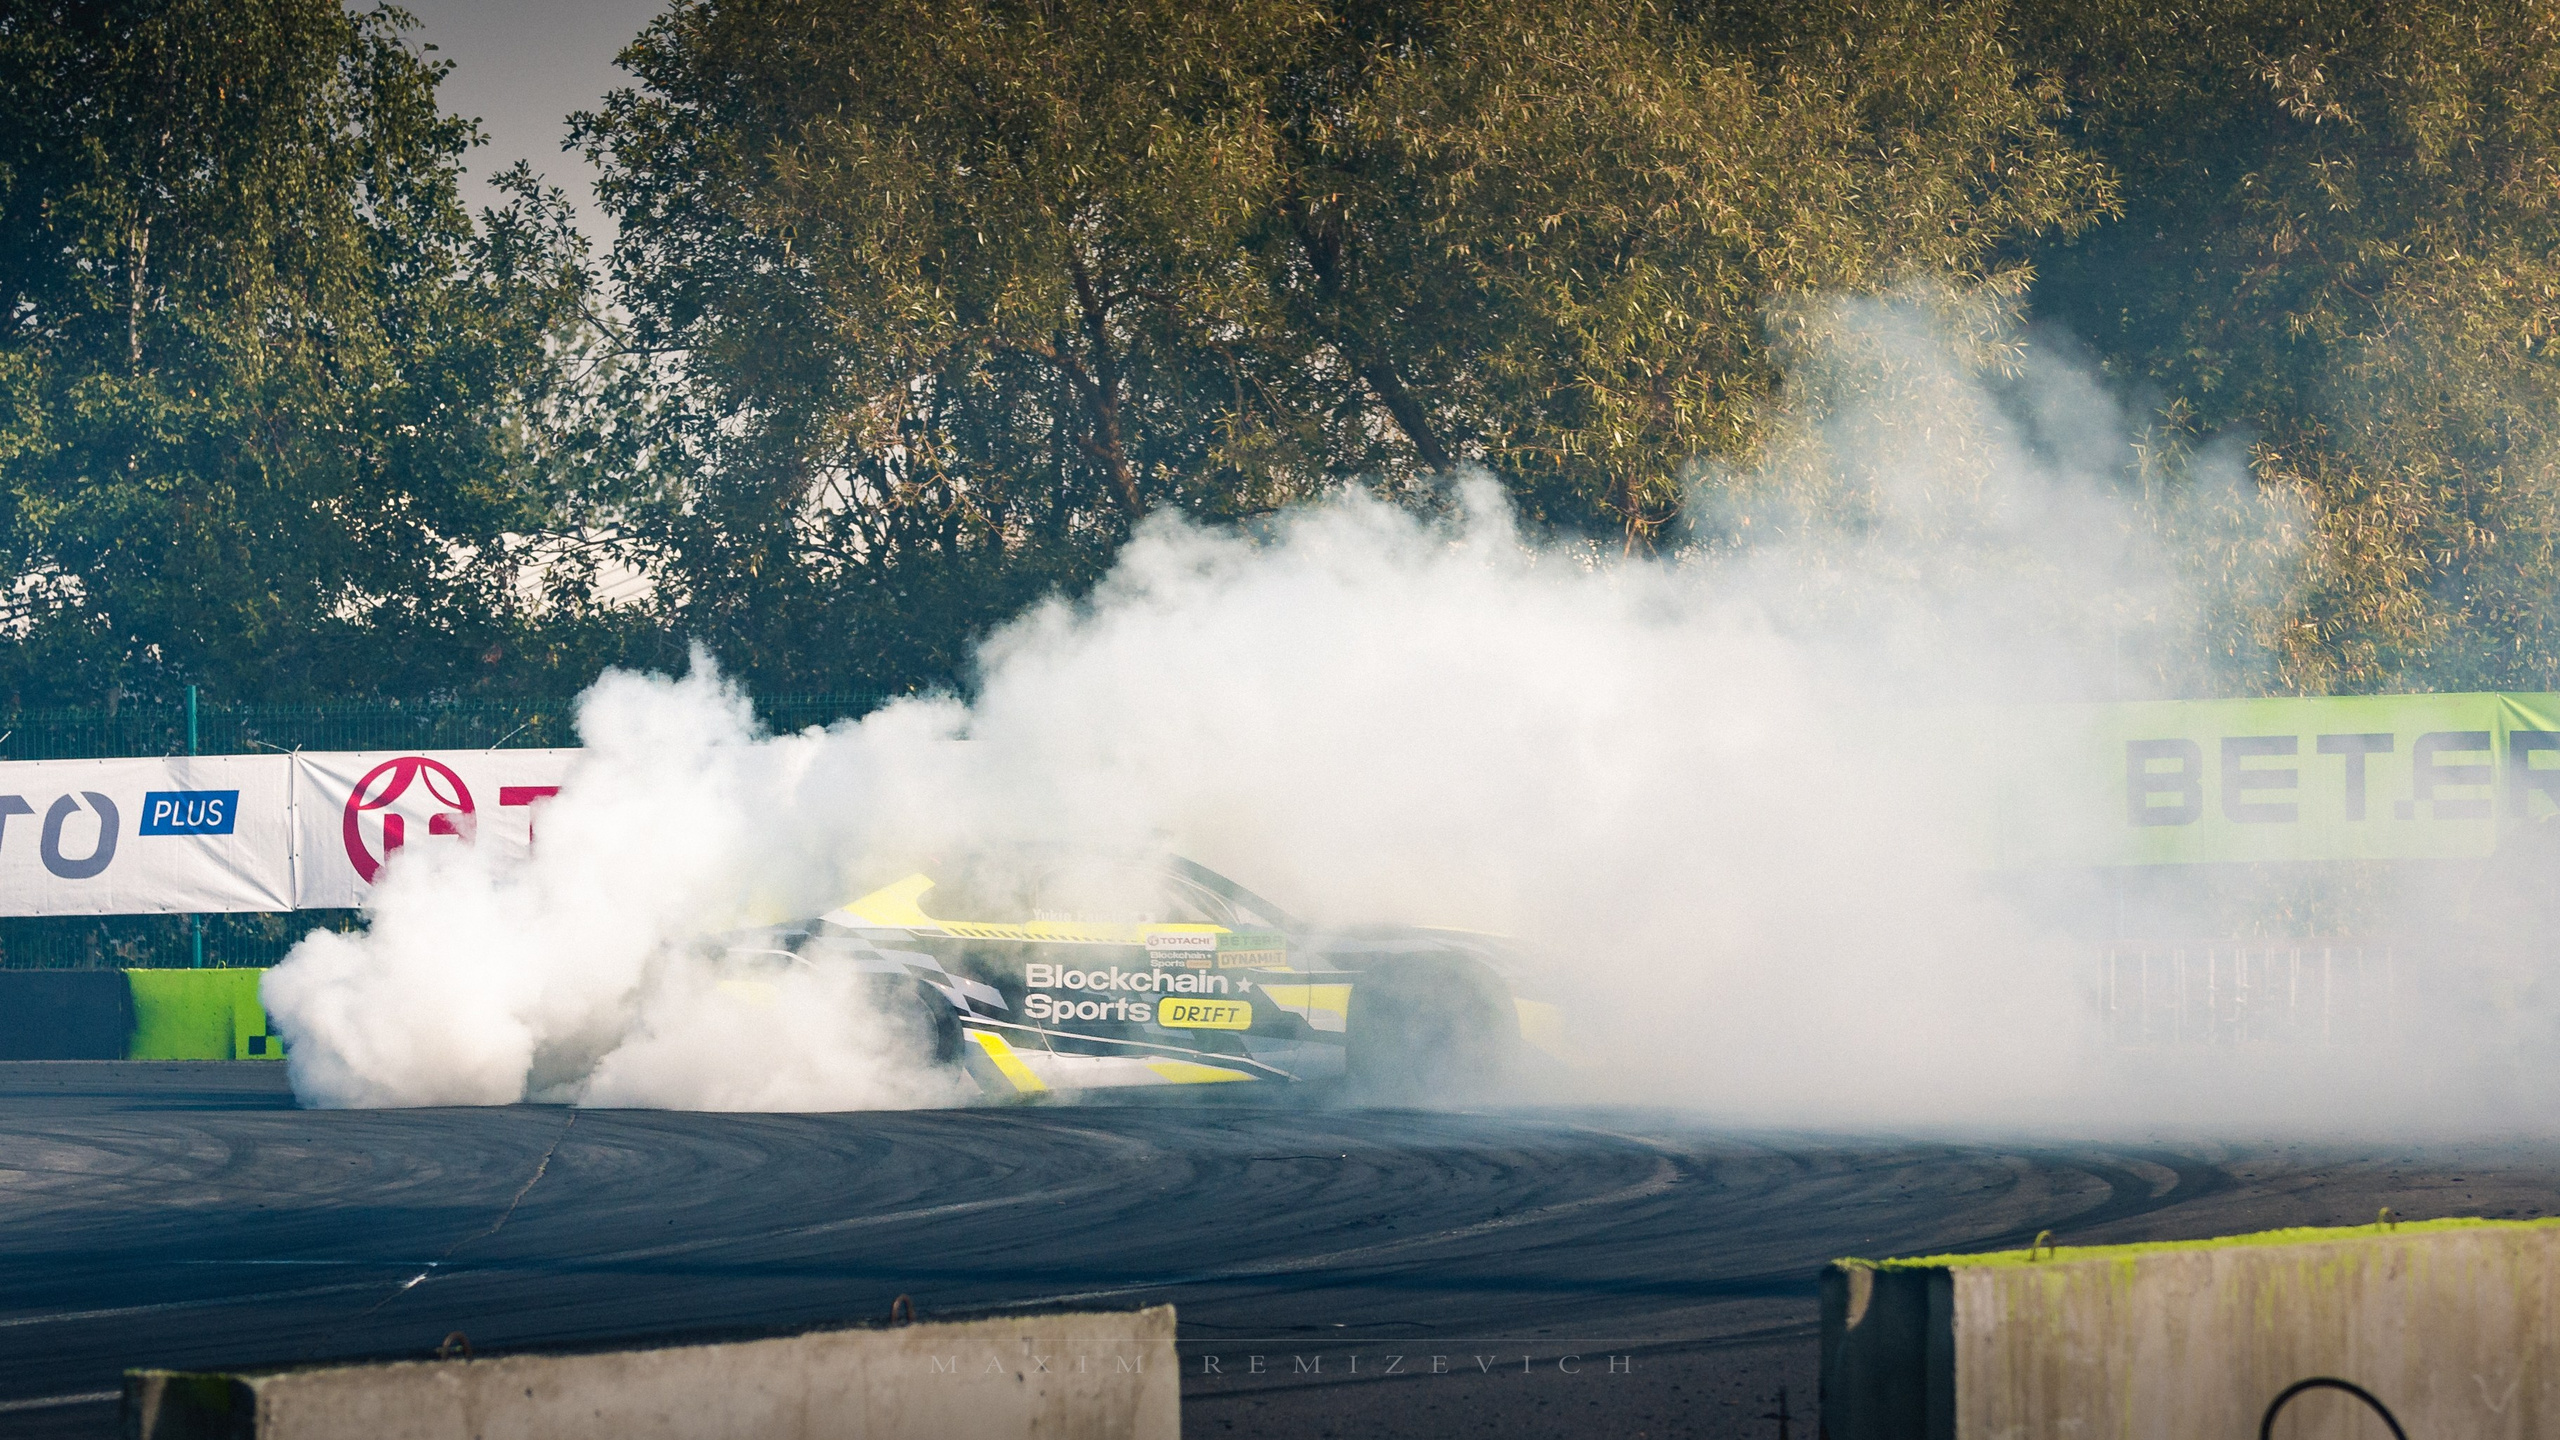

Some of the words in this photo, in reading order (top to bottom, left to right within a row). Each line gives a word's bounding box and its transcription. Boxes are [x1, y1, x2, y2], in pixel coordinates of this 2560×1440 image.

[153, 799, 224, 827] PLUS
[1159, 936, 1211, 946] TOTACHI
[1150, 950, 1206, 960] Blockchain
[1150, 960, 1186, 969] Sports
[1025, 963, 1229, 994] Blockchain
[1024, 993, 1151, 1025] Sports
[1172, 1006, 1240, 1023] DRIFT
